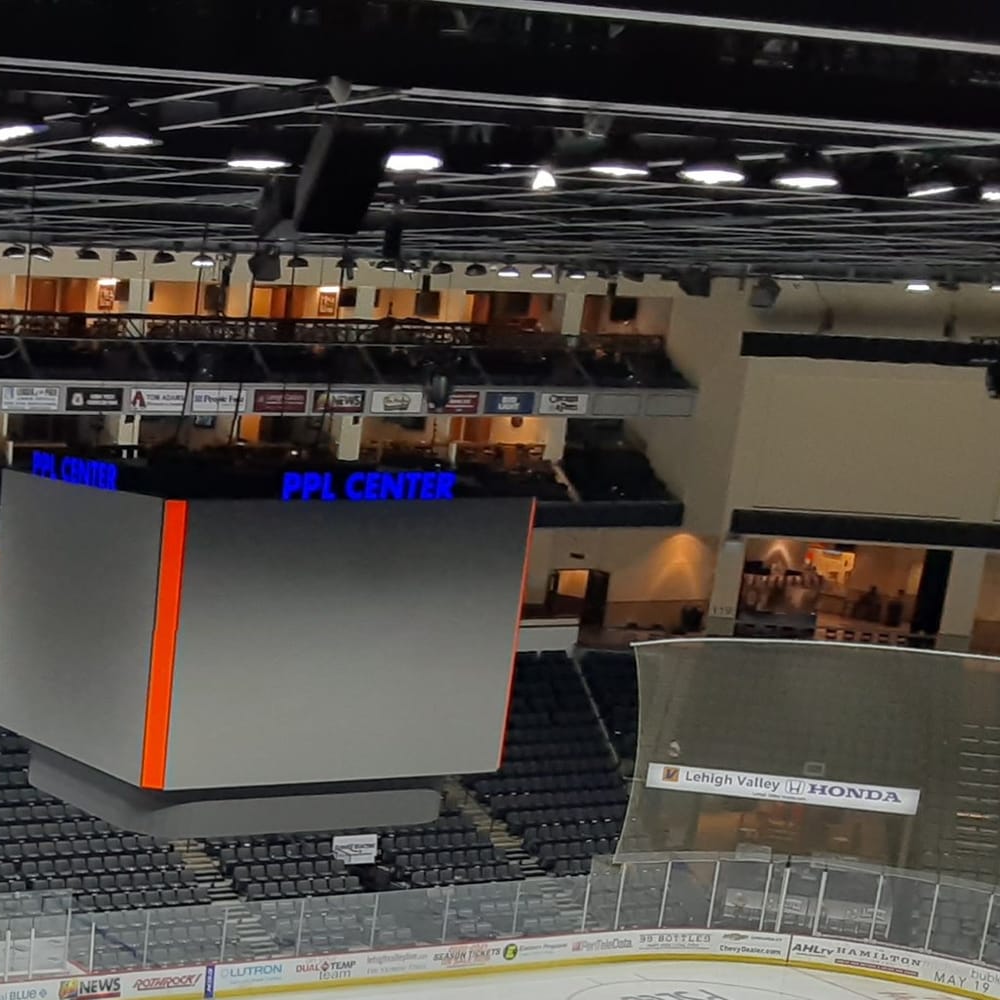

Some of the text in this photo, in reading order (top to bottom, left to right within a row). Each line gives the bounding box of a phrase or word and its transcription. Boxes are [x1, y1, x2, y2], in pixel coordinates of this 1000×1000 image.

[32, 449, 117, 491] PPL CENTER
[281, 472, 456, 501] PPL CENTER
[685, 772, 732, 786] Lehigh
[737, 776, 780, 792] Valley
[808, 784, 901, 803] HONDA
[296, 964, 319, 973] DUAL
[331, 961, 356, 970] TEMP
[836, 947, 921, 967] HAMILTON
[230, 964, 283, 977] LUTRON
[79, 977, 121, 995] NEWS
[933, 971, 990, 993] MAY 19
